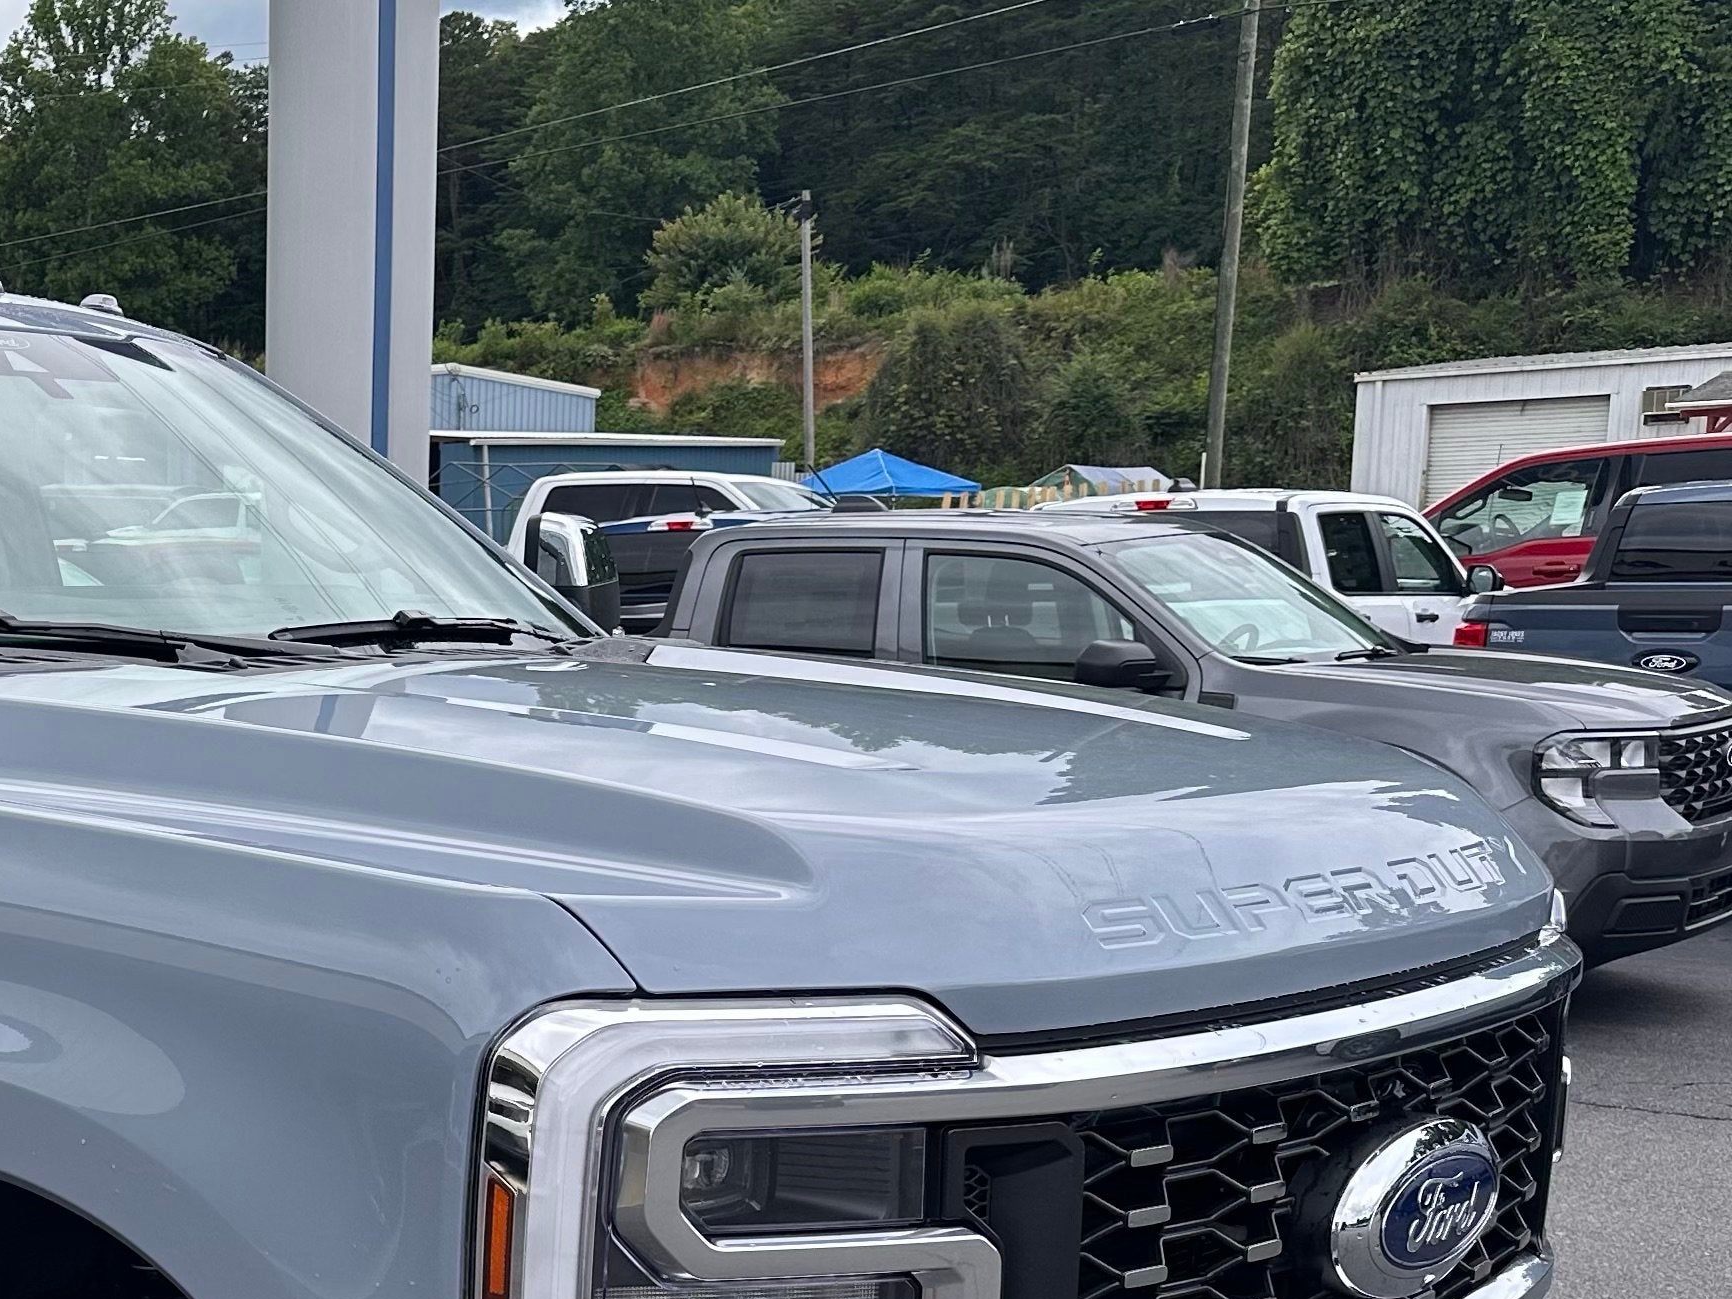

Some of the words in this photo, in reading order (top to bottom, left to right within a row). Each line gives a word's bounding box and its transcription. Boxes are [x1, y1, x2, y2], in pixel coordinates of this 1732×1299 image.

[1648, 657, 1678, 668] Ford
[1083, 866, 1400, 950] SUPER
[1387, 835, 1527, 903] DUTY
[1406, 1171, 1481, 1253] Ford
